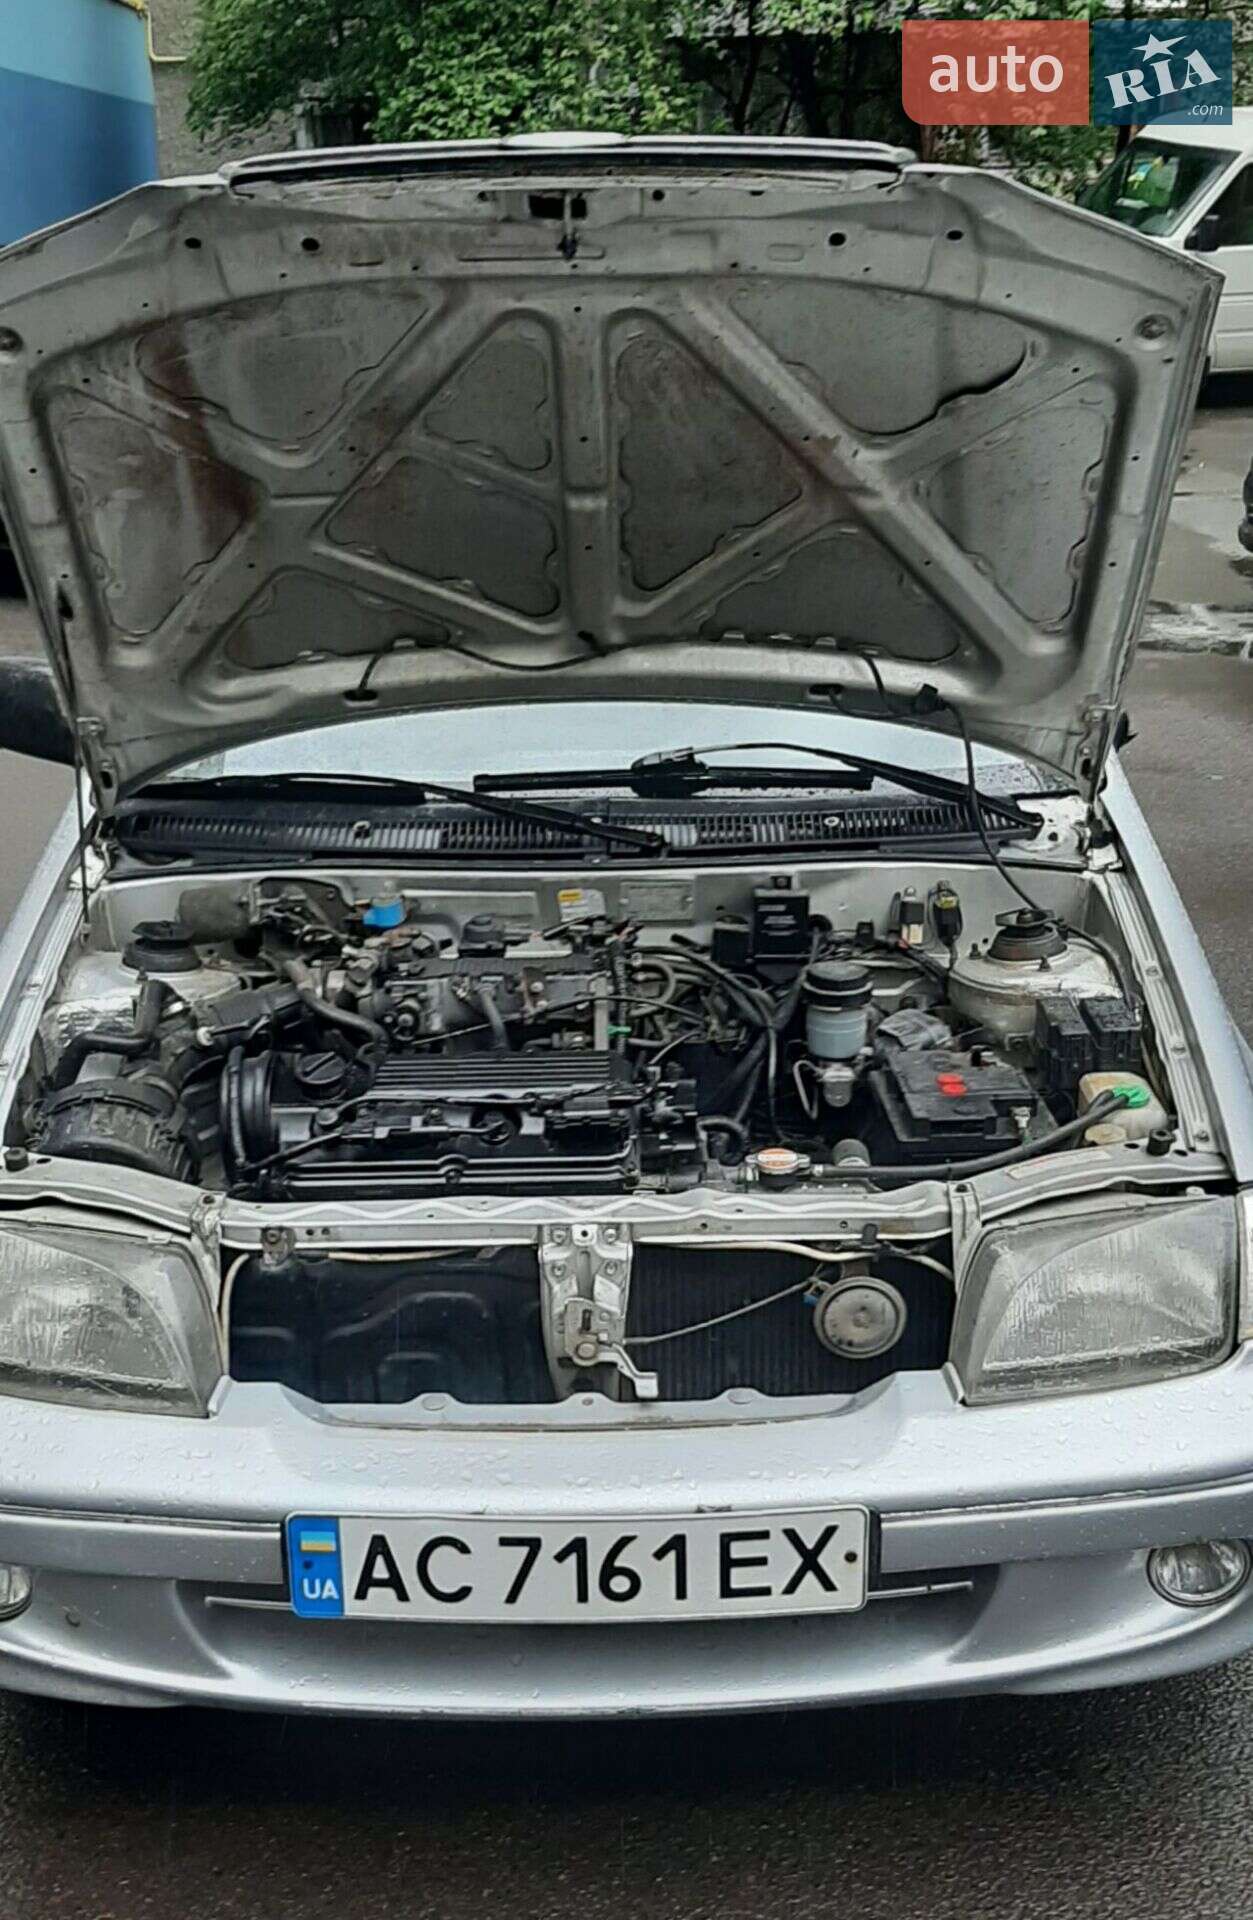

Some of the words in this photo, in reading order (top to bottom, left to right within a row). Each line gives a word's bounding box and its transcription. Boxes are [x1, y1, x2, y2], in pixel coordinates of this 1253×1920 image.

[302, 1578, 340, 1600] UA
[353, 1534, 473, 1604] AC
[498, 1534, 688, 1605] 7161
[719, 1525, 839, 1600] EX
